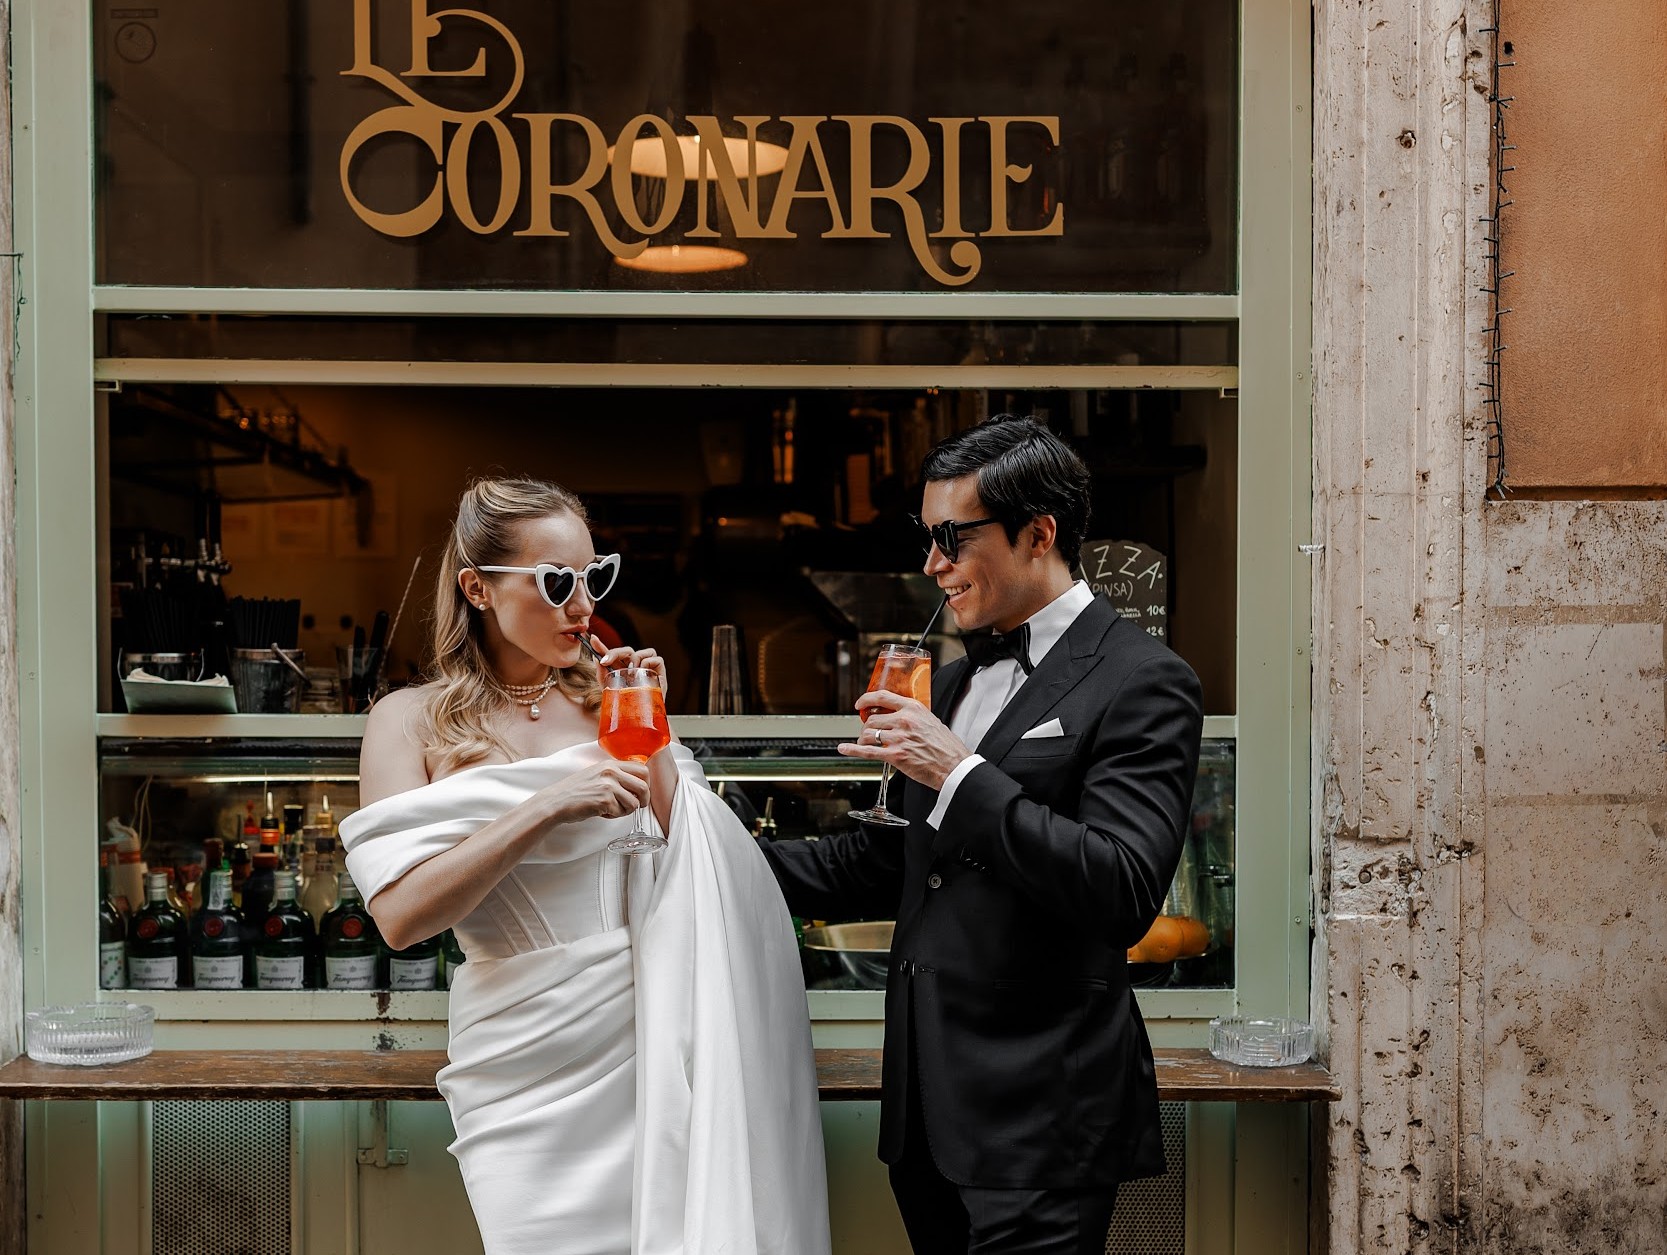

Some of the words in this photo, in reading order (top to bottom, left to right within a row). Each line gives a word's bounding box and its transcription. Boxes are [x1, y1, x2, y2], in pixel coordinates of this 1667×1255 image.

[340, 0, 525, 120] LE
[340, 105, 1065, 286] CORONARIE
[1146, 604, 1166, 617] 10€
